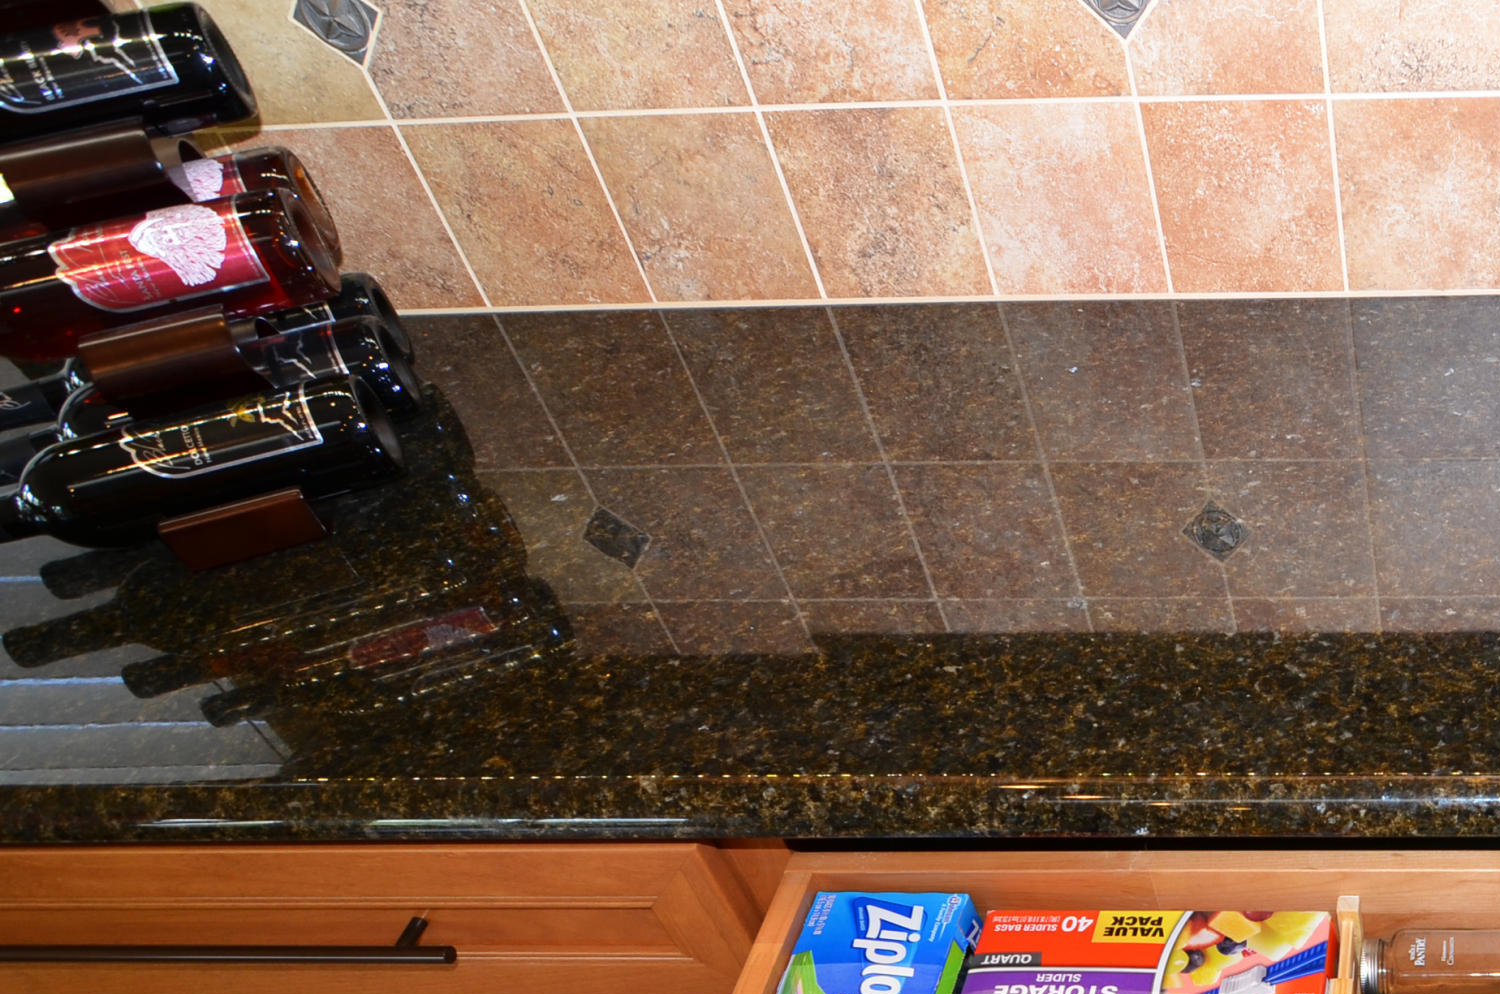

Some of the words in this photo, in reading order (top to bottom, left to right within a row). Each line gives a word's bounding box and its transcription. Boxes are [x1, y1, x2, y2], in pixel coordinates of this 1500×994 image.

[1061, 915, 1094, 934] 40
[1111, 916, 1164, 926] PACK
[993, 922, 1021, 932] BAGS
[1022, 923, 1058, 933] SLIDER
[1102, 925, 1165, 938] VALUE
[1413, 937, 1427, 967] PANTRY
[980, 954, 1032, 966] QUART
[1036, 973, 1082, 983] SLIDER
